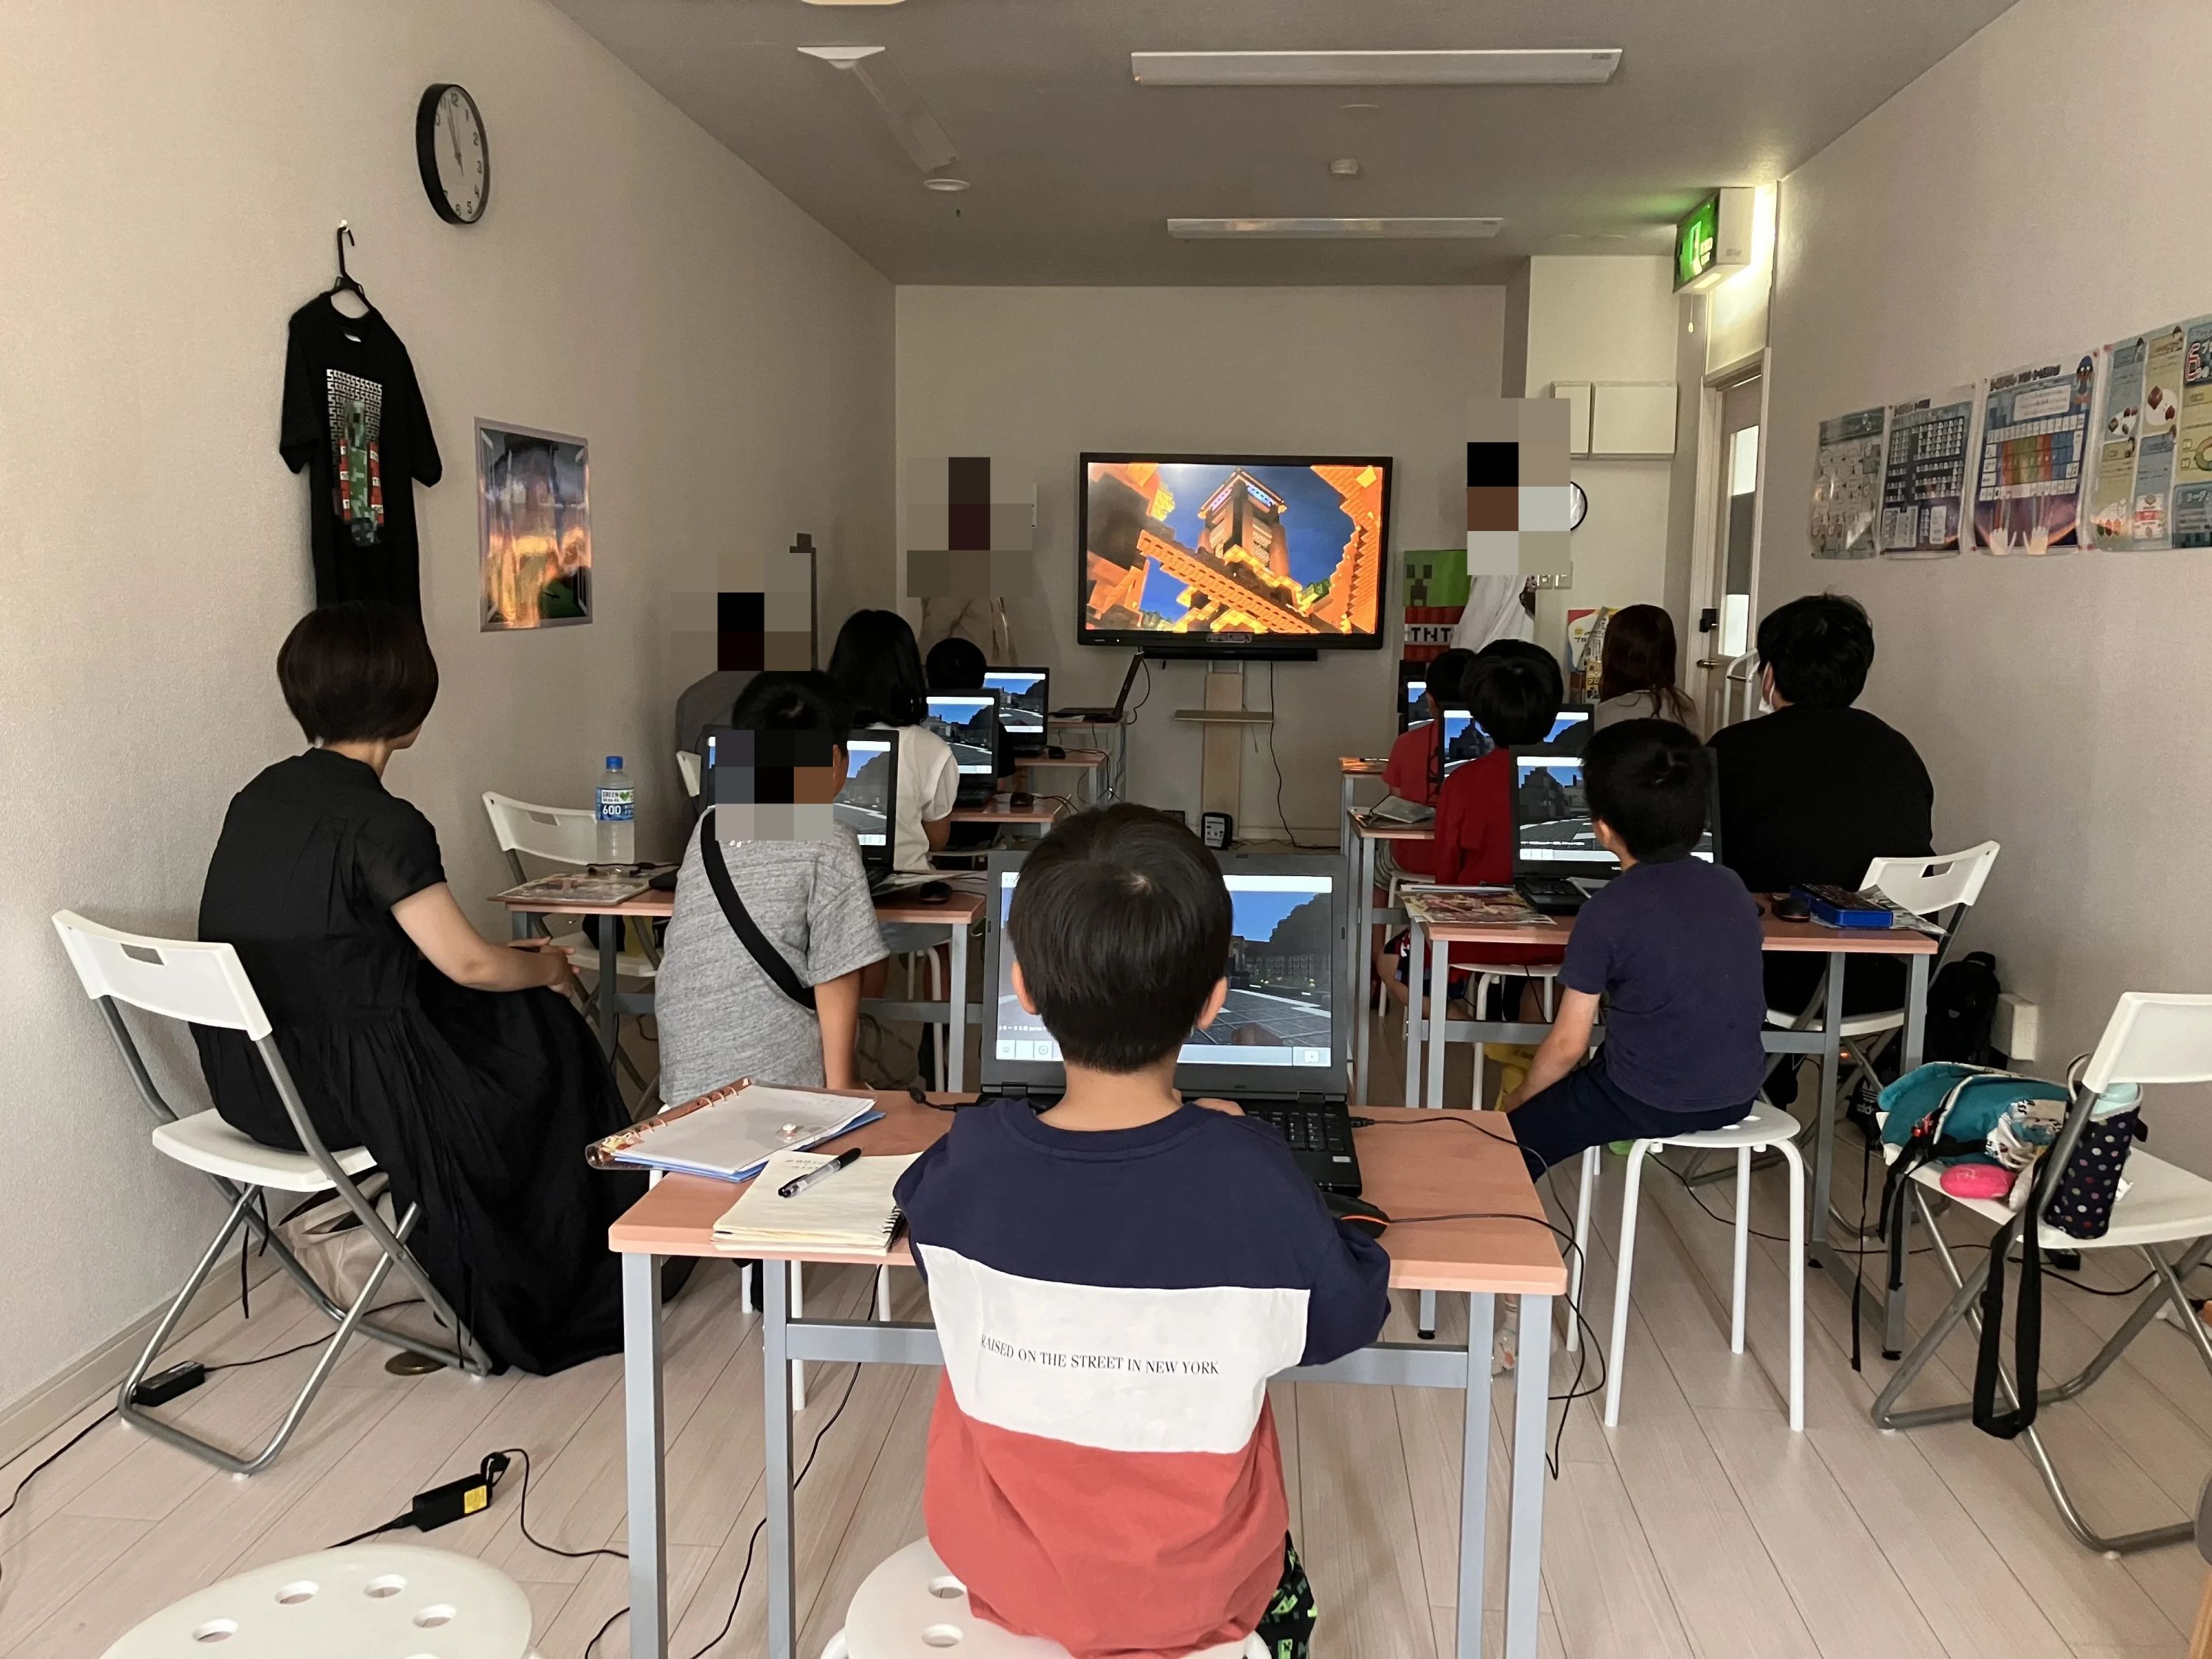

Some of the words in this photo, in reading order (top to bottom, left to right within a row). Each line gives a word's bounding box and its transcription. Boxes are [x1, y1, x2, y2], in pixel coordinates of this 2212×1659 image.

[450, 91, 458, 107] 12
[473, 132, 479, 146] 2
[477, 160, 481, 174] 3
[474, 184, 479, 198] 4
[467, 201, 472, 214] 5
[1411, 627, 1451, 641] TNT
[602, 804, 621, 815] 600
[981, 1334, 1014, 1358] RAISED
[1018, 1348, 1036, 1363] ON
[1040, 1352, 1066, 1368] THE
[1071, 1354, 1123, 1369] STREET
[1128, 1358, 1141, 1371] IN
[1146, 1360, 1178, 1373] NEW
[1183, 1361, 1219, 1374] YORK
